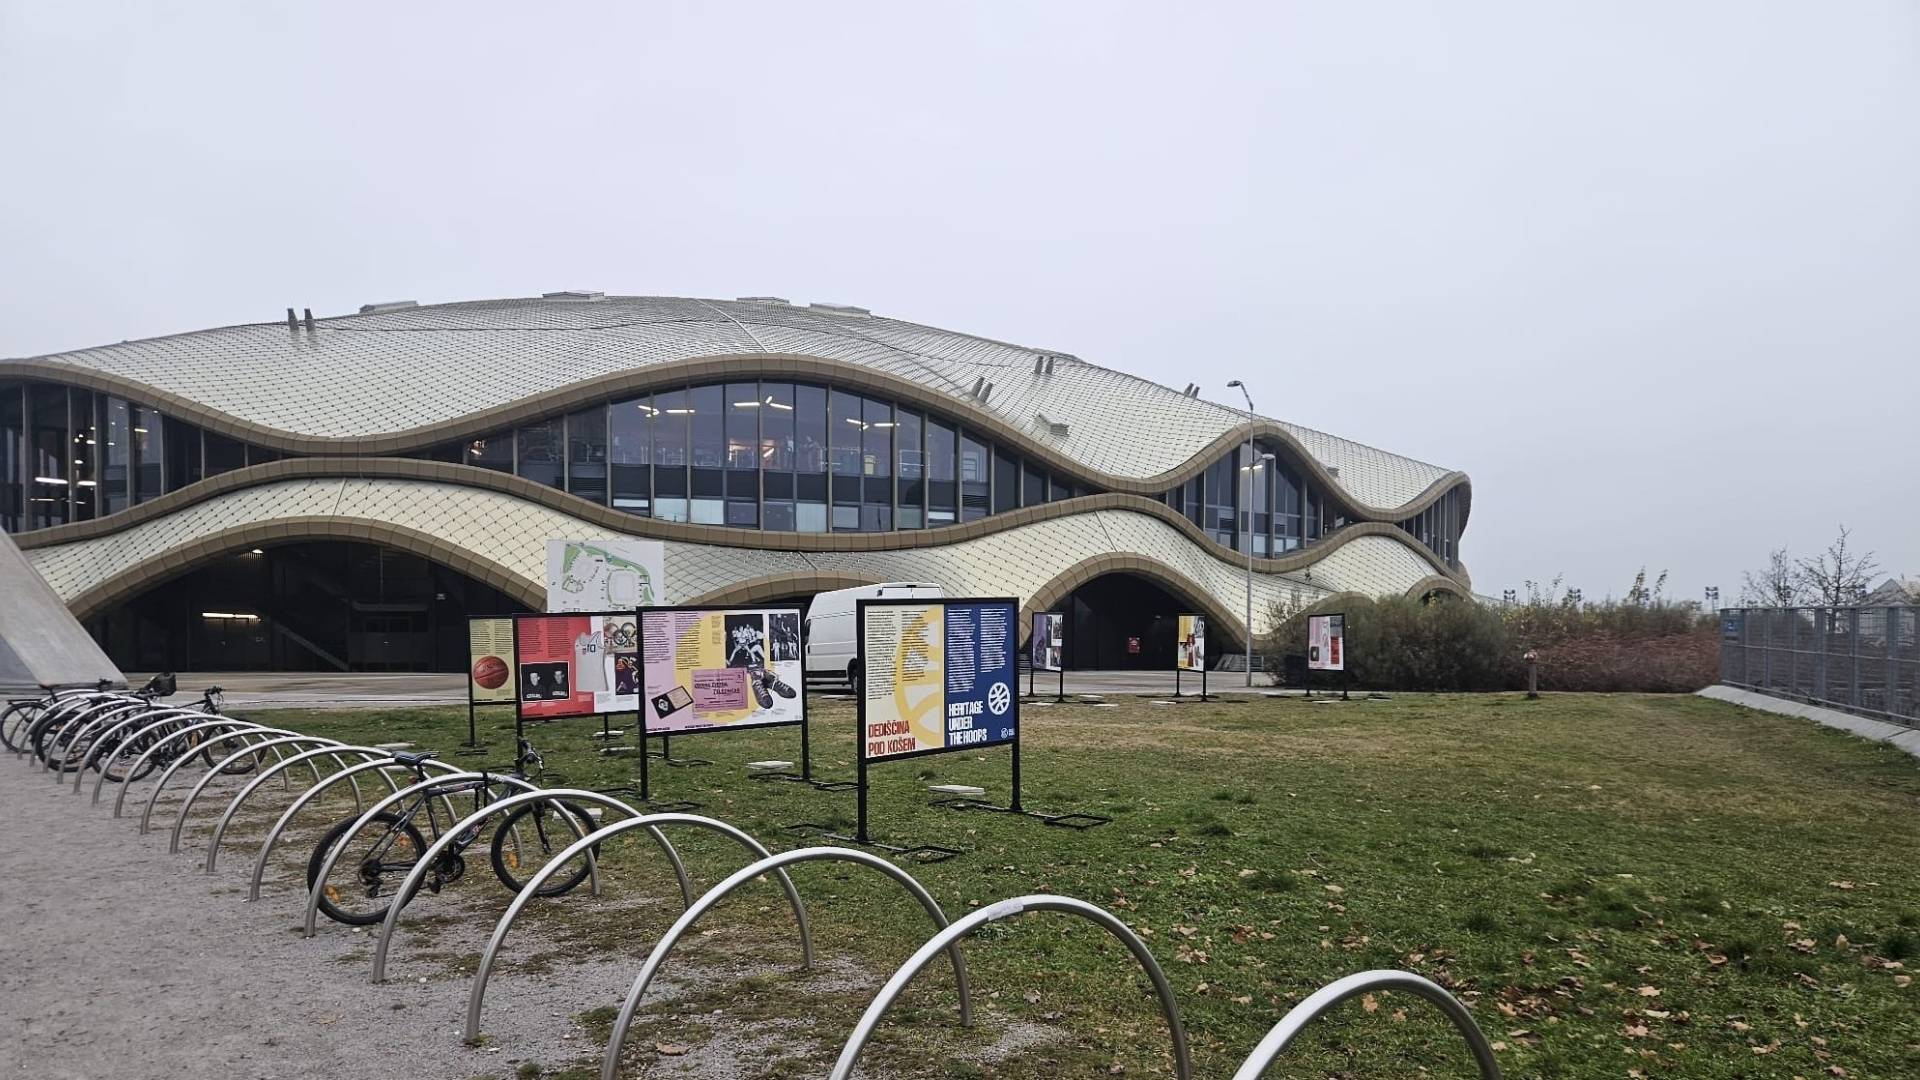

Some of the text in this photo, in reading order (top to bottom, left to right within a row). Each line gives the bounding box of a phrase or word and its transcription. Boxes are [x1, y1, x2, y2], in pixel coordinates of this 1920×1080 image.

[949, 701, 984, 717] HERITAGE
[869, 720, 909, 738] DEDIŠČINA
[949, 716, 972, 731] UNDER
[949, 728, 987, 745] THE HOOPS
[869, 736, 916, 756] POD KOŠEM
